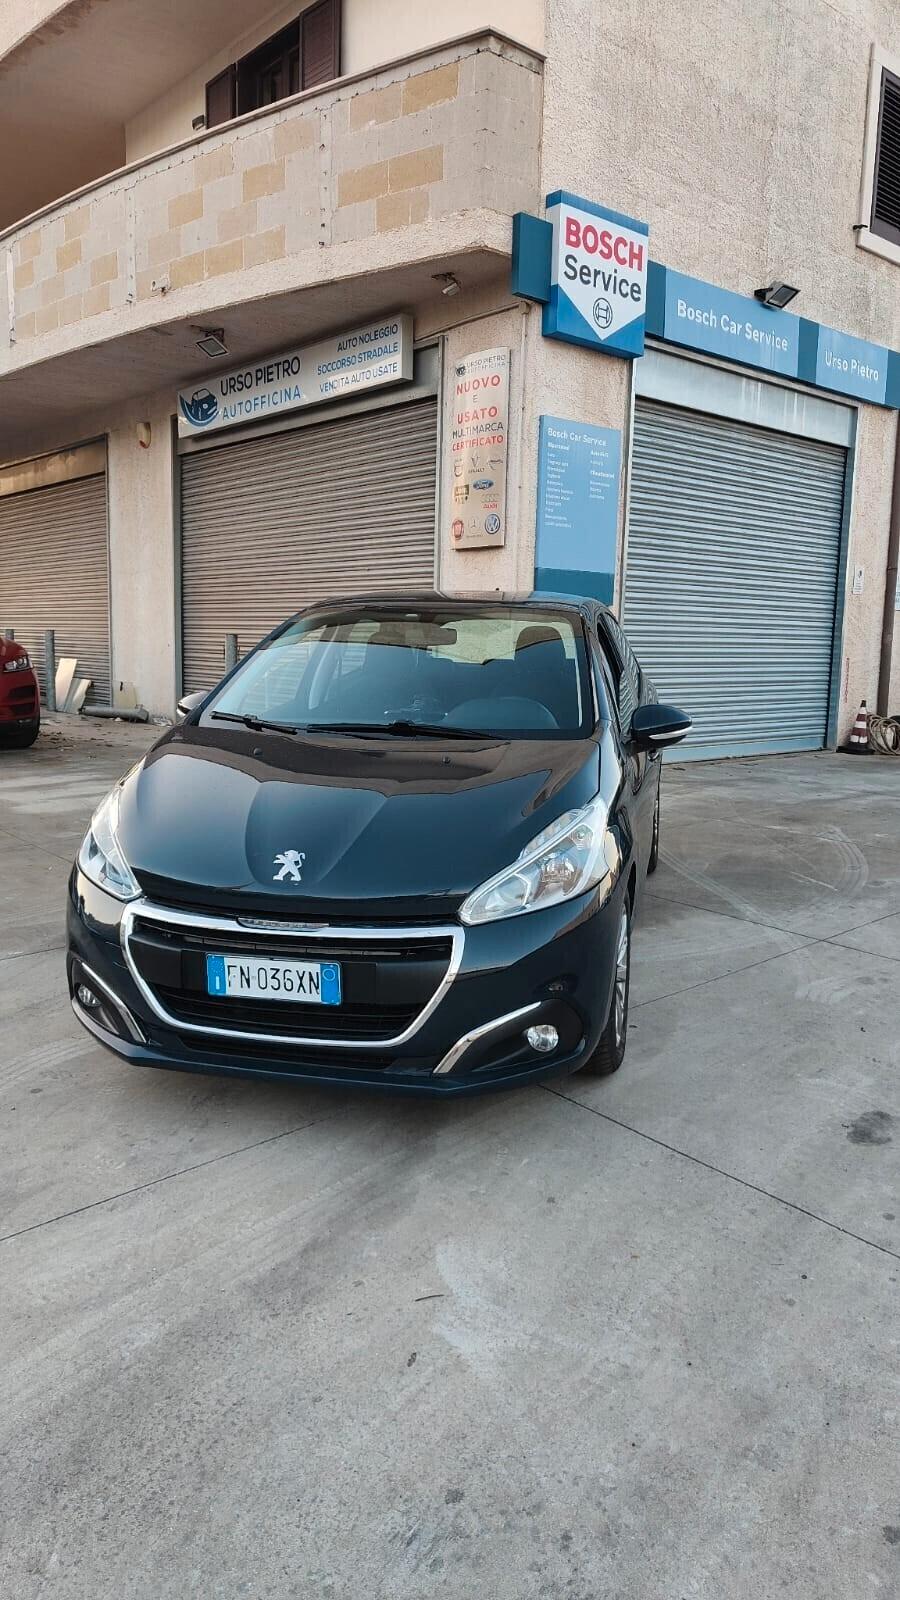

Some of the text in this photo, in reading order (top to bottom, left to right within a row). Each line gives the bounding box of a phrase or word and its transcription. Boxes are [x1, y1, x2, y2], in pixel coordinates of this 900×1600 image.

[565, 217, 644, 272] BOSCH
[563, 254, 642, 303] Service
[337, 323, 399, 352] AUTO NOLEGGIO
[677, 299, 789, 352] Bosch Car Service
[317, 342, 399, 376] SOCCORSO STRADALE
[825, 350, 879, 382] Urso Pietro
[220, 356, 301, 396] URSO PIETRO
[319, 362, 398, 393] VENDITA AUTO USATE
[456, 374, 501, 396] NUOVO
[222, 384, 301, 421] AUTOFFICINA
[472, 394, 479, 403] E
[452, 421, 505, 440] MULTIMARCA
[457, 406, 498, 425] USATO
[452, 434, 504, 452] CERTIFICATO
[547, 427, 568, 440] Bosch
[569, 432, 582, 441] Car
[583, 435, 606, 447] Service
[257, 967, 321, 995] 036XN
